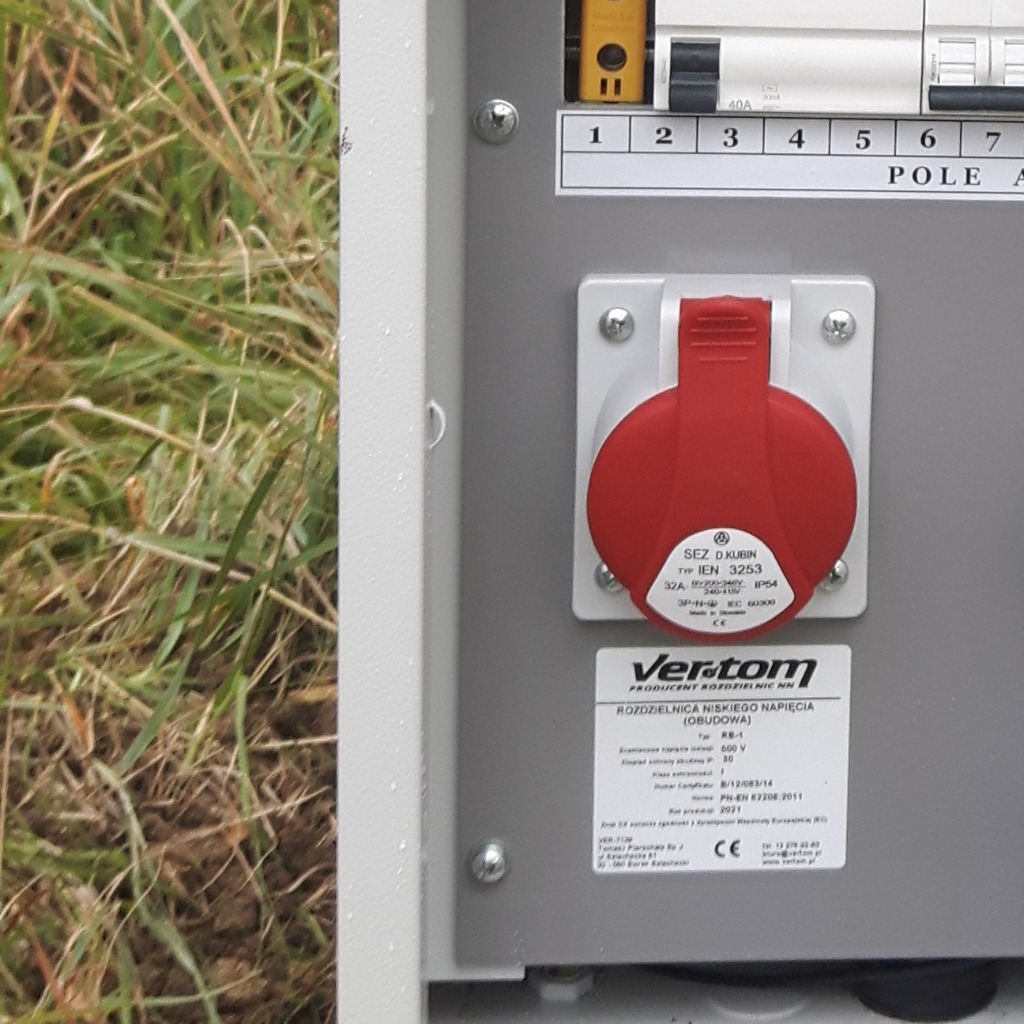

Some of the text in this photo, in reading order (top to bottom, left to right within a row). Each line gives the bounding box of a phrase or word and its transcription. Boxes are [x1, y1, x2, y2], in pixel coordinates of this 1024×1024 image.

[728, 99, 753, 111] 40A
[588, 126, 603, 145] 1
[655, 126, 674, 145] 2
[723, 127, 739, 148] 3
[788, 128, 806, 149] 4
[855, 129, 872, 150] 5
[920, 128, 937, 149] 6
[985, 132, 1002, 152] 7
[888, 165, 982, 187] POLE
[684, 548, 711, 560] SEZ
[678, 563, 763, 576] TYP IEN 3253
[754, 579, 778, 590] IP54
[727, 599, 742, 607] IEC
[628, 681, 796, 693] PRODUCENT ROZDZIELNIC NN
[616, 701, 815, 716] ROZDZIELNICA NISKIEGO NAPIĘCIA
[683, 715, 752, 726] (OBUDOWA)
[740, 744, 747, 752] V
